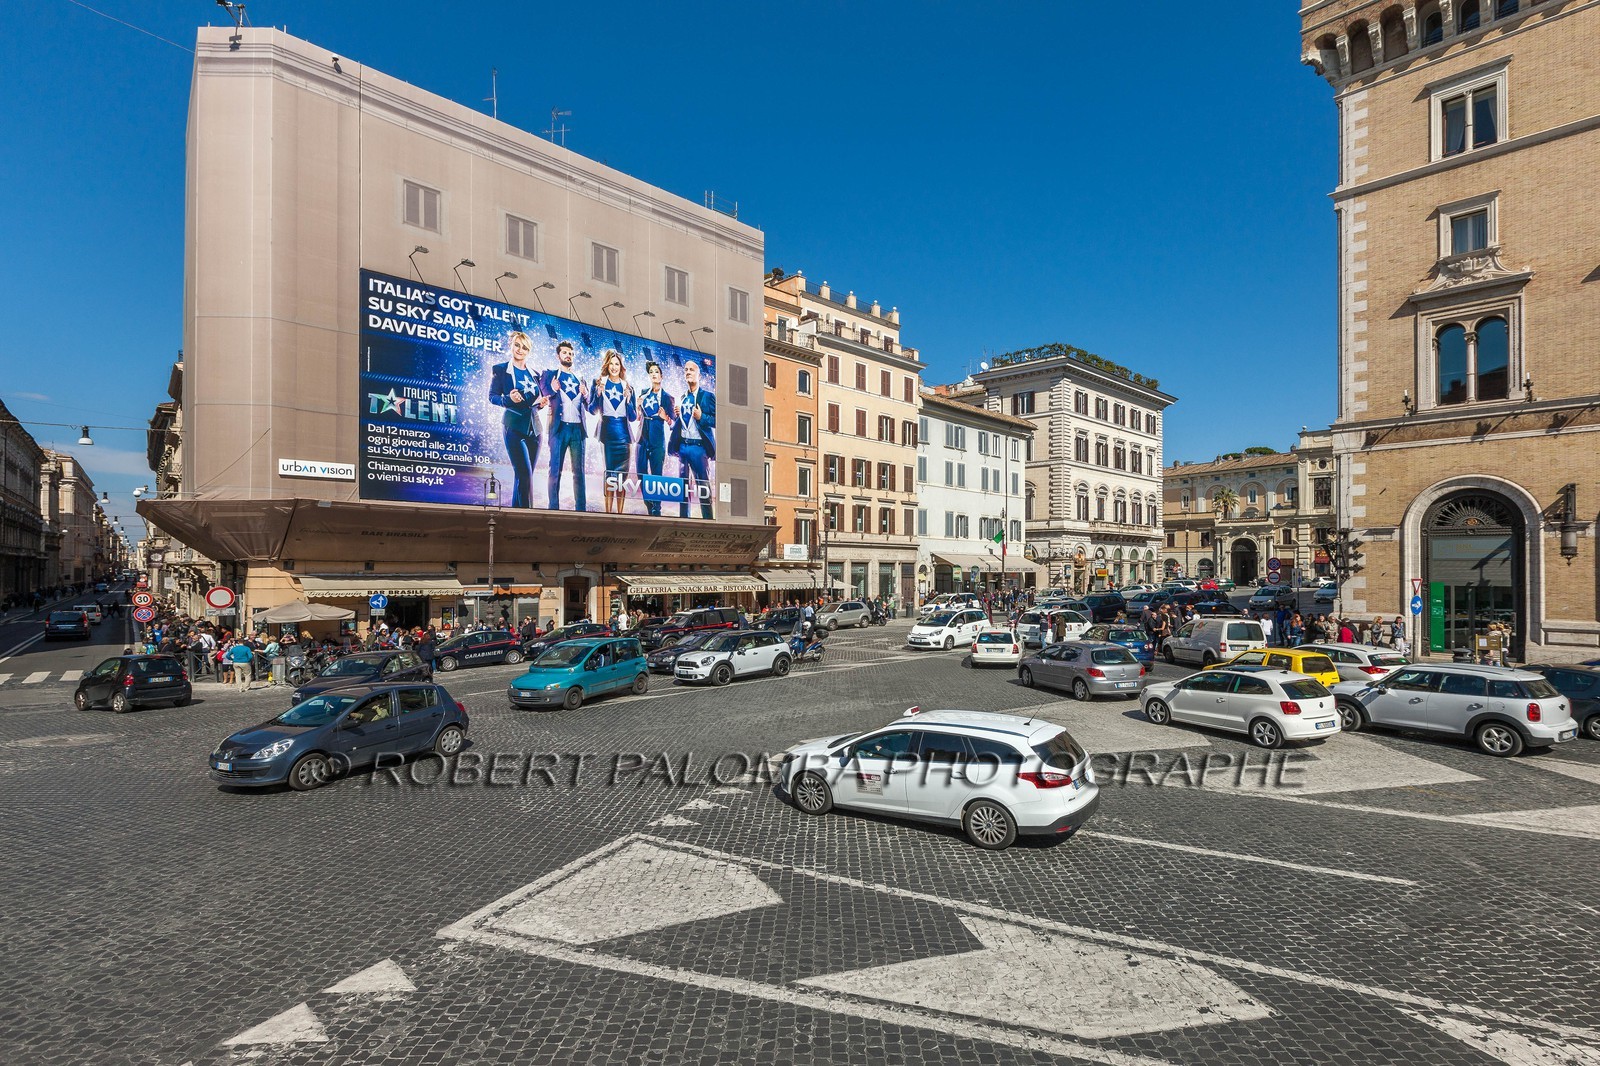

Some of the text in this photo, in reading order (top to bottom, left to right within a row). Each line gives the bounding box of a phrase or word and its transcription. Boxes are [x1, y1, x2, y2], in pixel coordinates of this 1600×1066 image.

[369, 278, 530, 326] ITALIA'S GOT TALENT
[368, 297, 476, 330] SU SKY SARÀ
[368, 315, 450, 342] DAVVERO
[404, 386, 458, 404] ITALIA'S GOT
[368, 424, 430, 438] Dal 12 marzo
[368, 435, 468, 452] ogni giovedì alle 21.10
[382, 446, 400, 457] Sky
[402, 449, 423, 457] Uno
[425, 451, 442, 460] HD,
[443, 453, 472, 462] canale
[320, 466, 352, 475] vision
[368, 461, 455, 476] Chiamaci 02.7070
[377, 472, 400, 482] vieni
[416, 476, 444, 486] sky.it
[606, 473, 710, 499] sky UNO HD
[630, 585, 672, 593] GELATERIA
[465, 650, 503, 659] CARABINIERI
